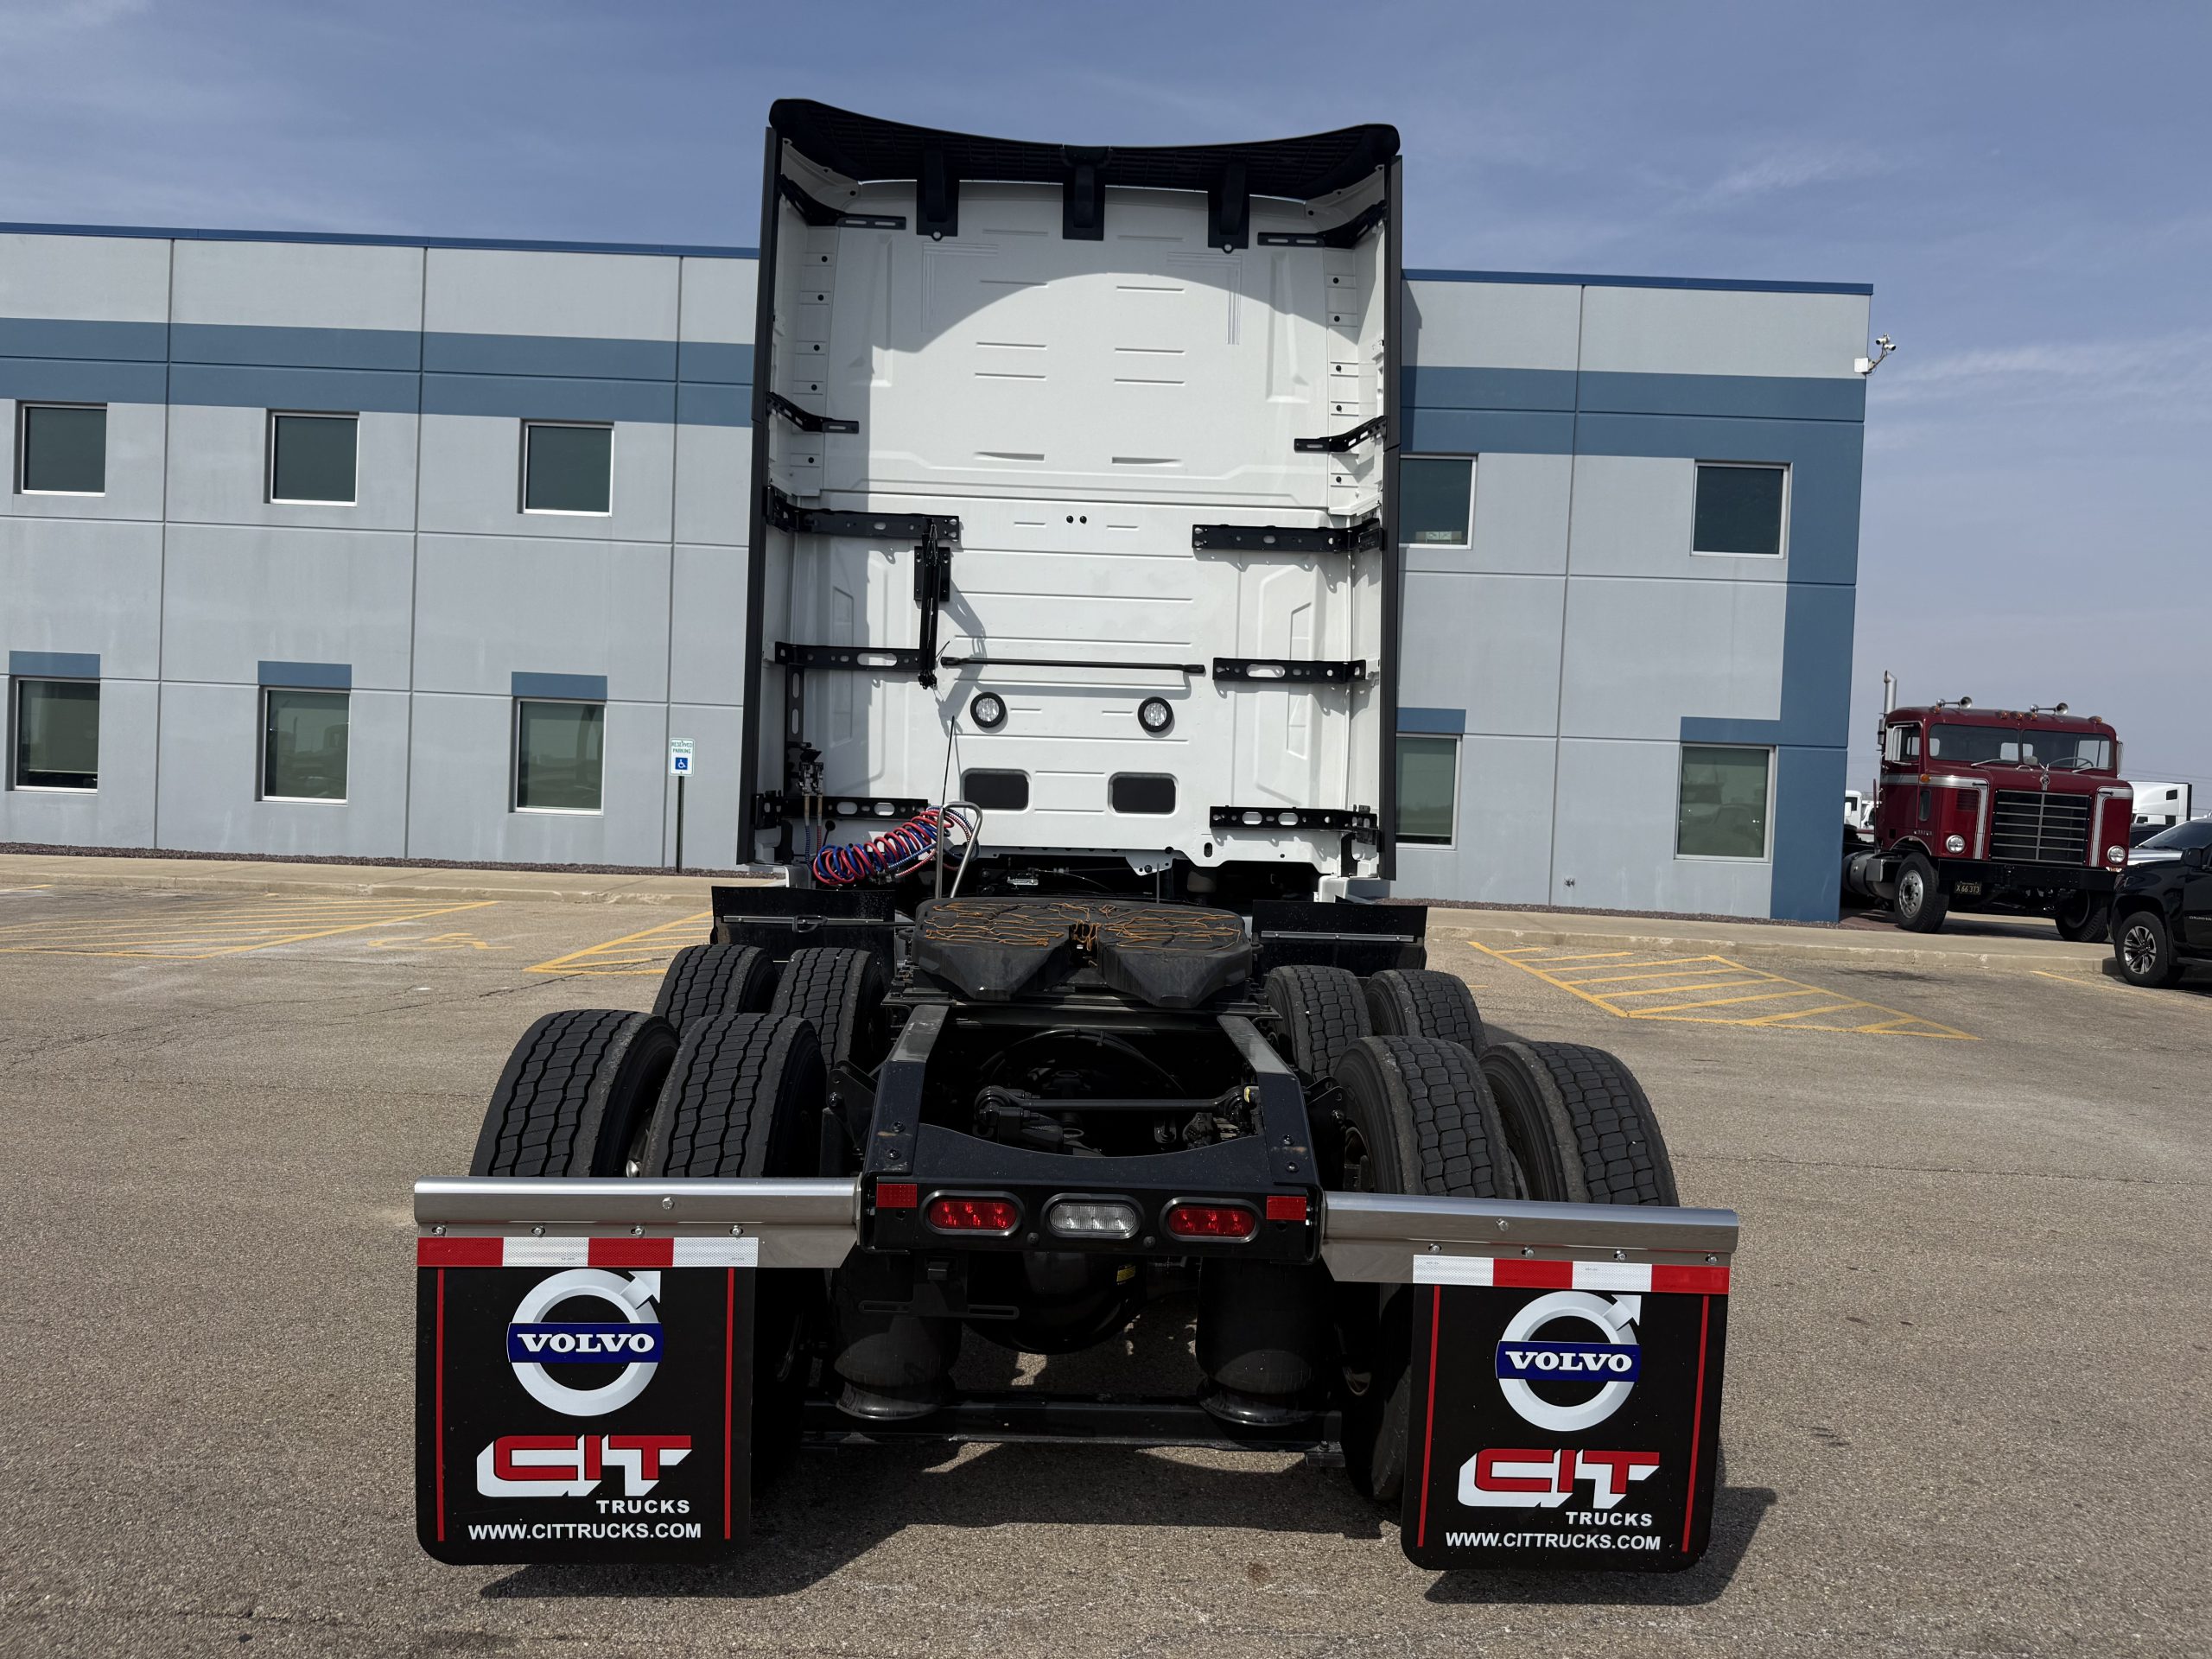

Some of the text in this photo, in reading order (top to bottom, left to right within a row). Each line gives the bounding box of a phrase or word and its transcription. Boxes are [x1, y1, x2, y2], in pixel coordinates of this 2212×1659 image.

[518, 1333, 655, 1353] VOLVO
[1505, 1351, 1633, 1372] VOLVO
[477, 1434, 692, 1497] CIT
[1458, 1448, 1660, 1509] CIT
[596, 1499, 690, 1514] TRUCKS
[1566, 1512, 1653, 1527] TRUCKS
[467, 1523, 702, 1540] WWW.CITTRUCKS.COM
[1446, 1532, 1661, 1551] WWW.CITTRUCKS.COM
